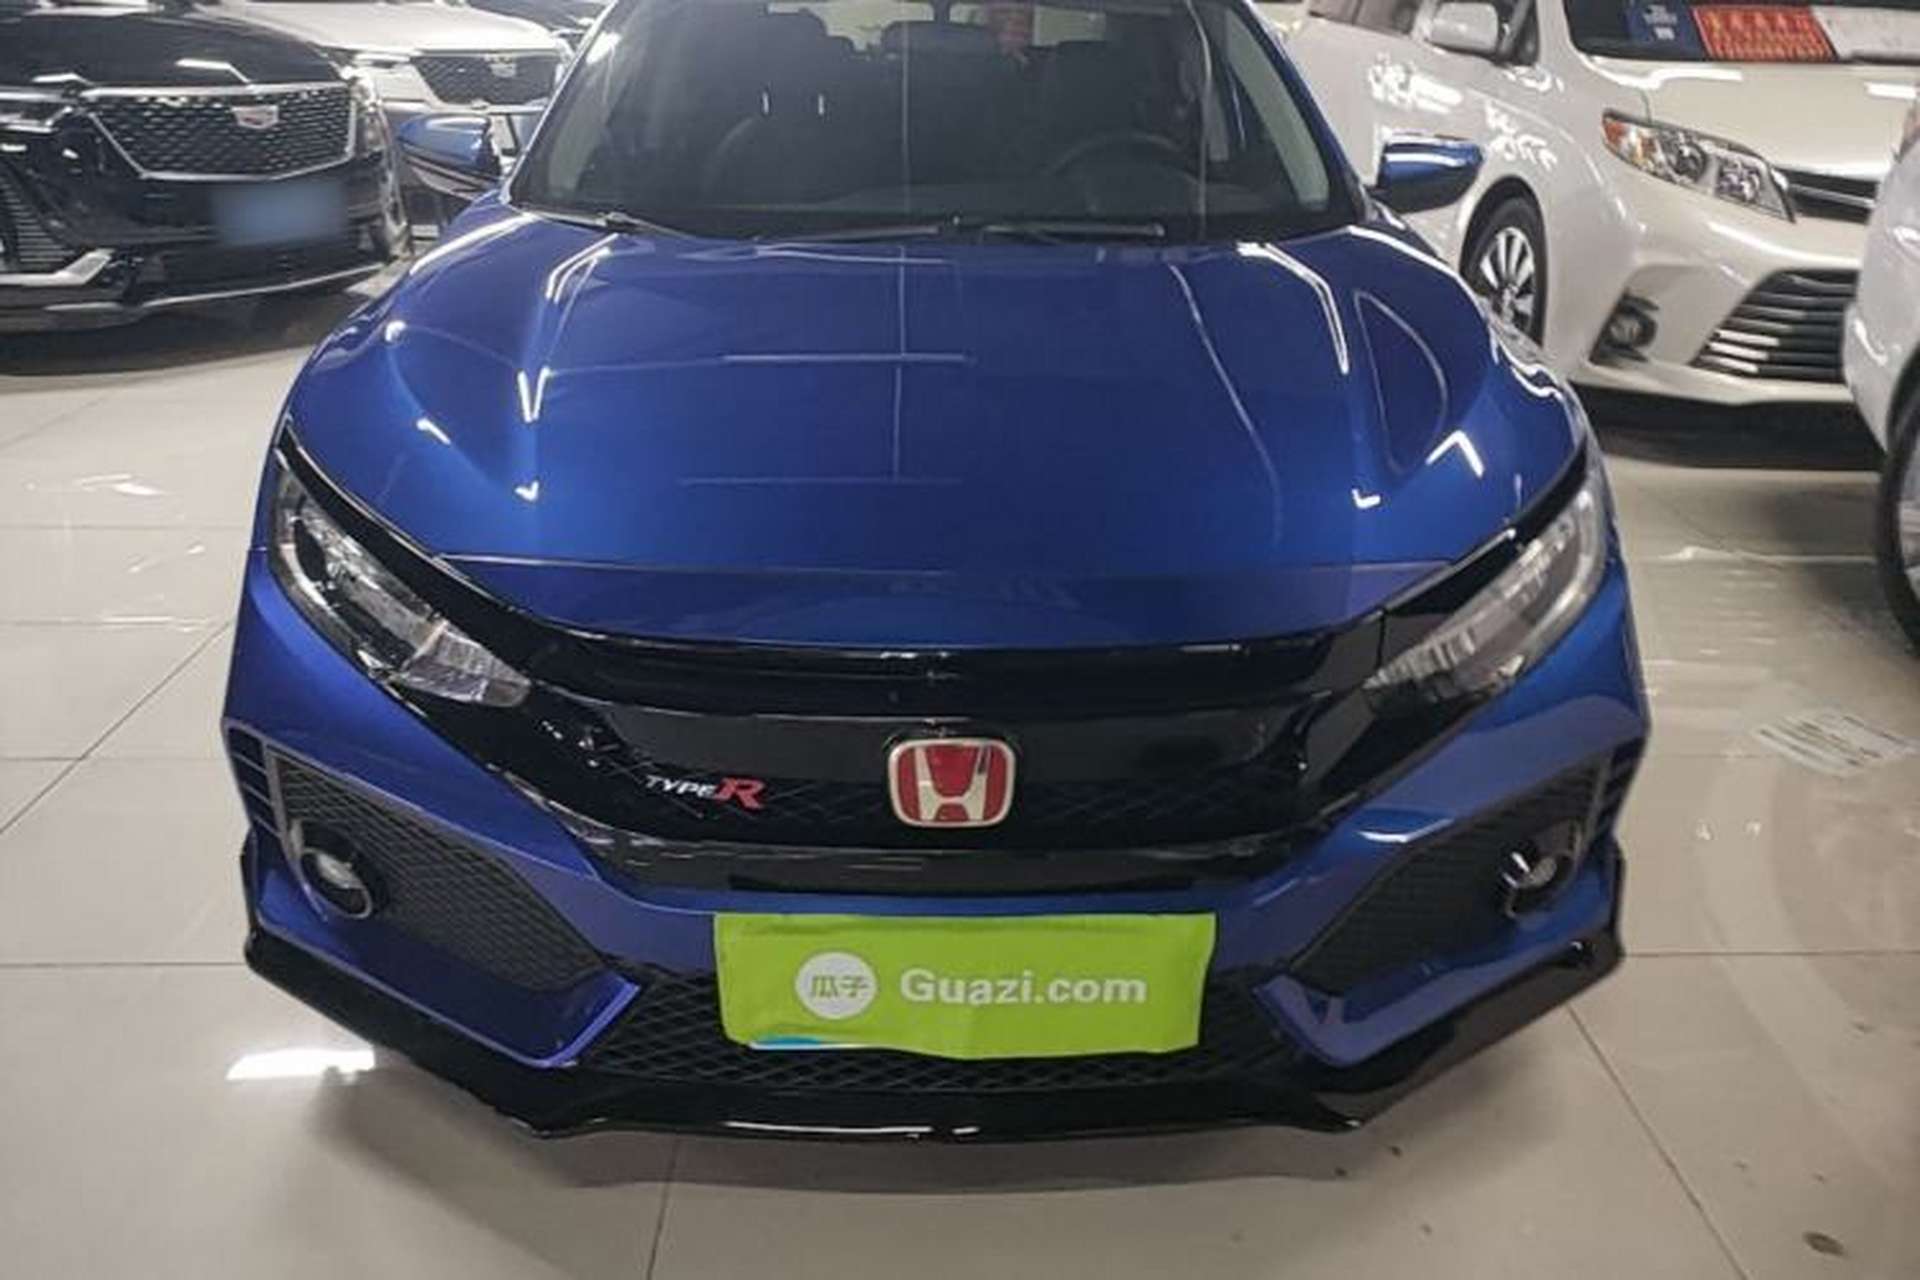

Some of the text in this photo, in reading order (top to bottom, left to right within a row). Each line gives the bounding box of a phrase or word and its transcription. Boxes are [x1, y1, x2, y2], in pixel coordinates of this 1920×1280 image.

[646, 774, 765, 808] TYPE R
[809, 973, 868, 999] 瓜子
[899, 967, 1148, 1005] Guazi.com
